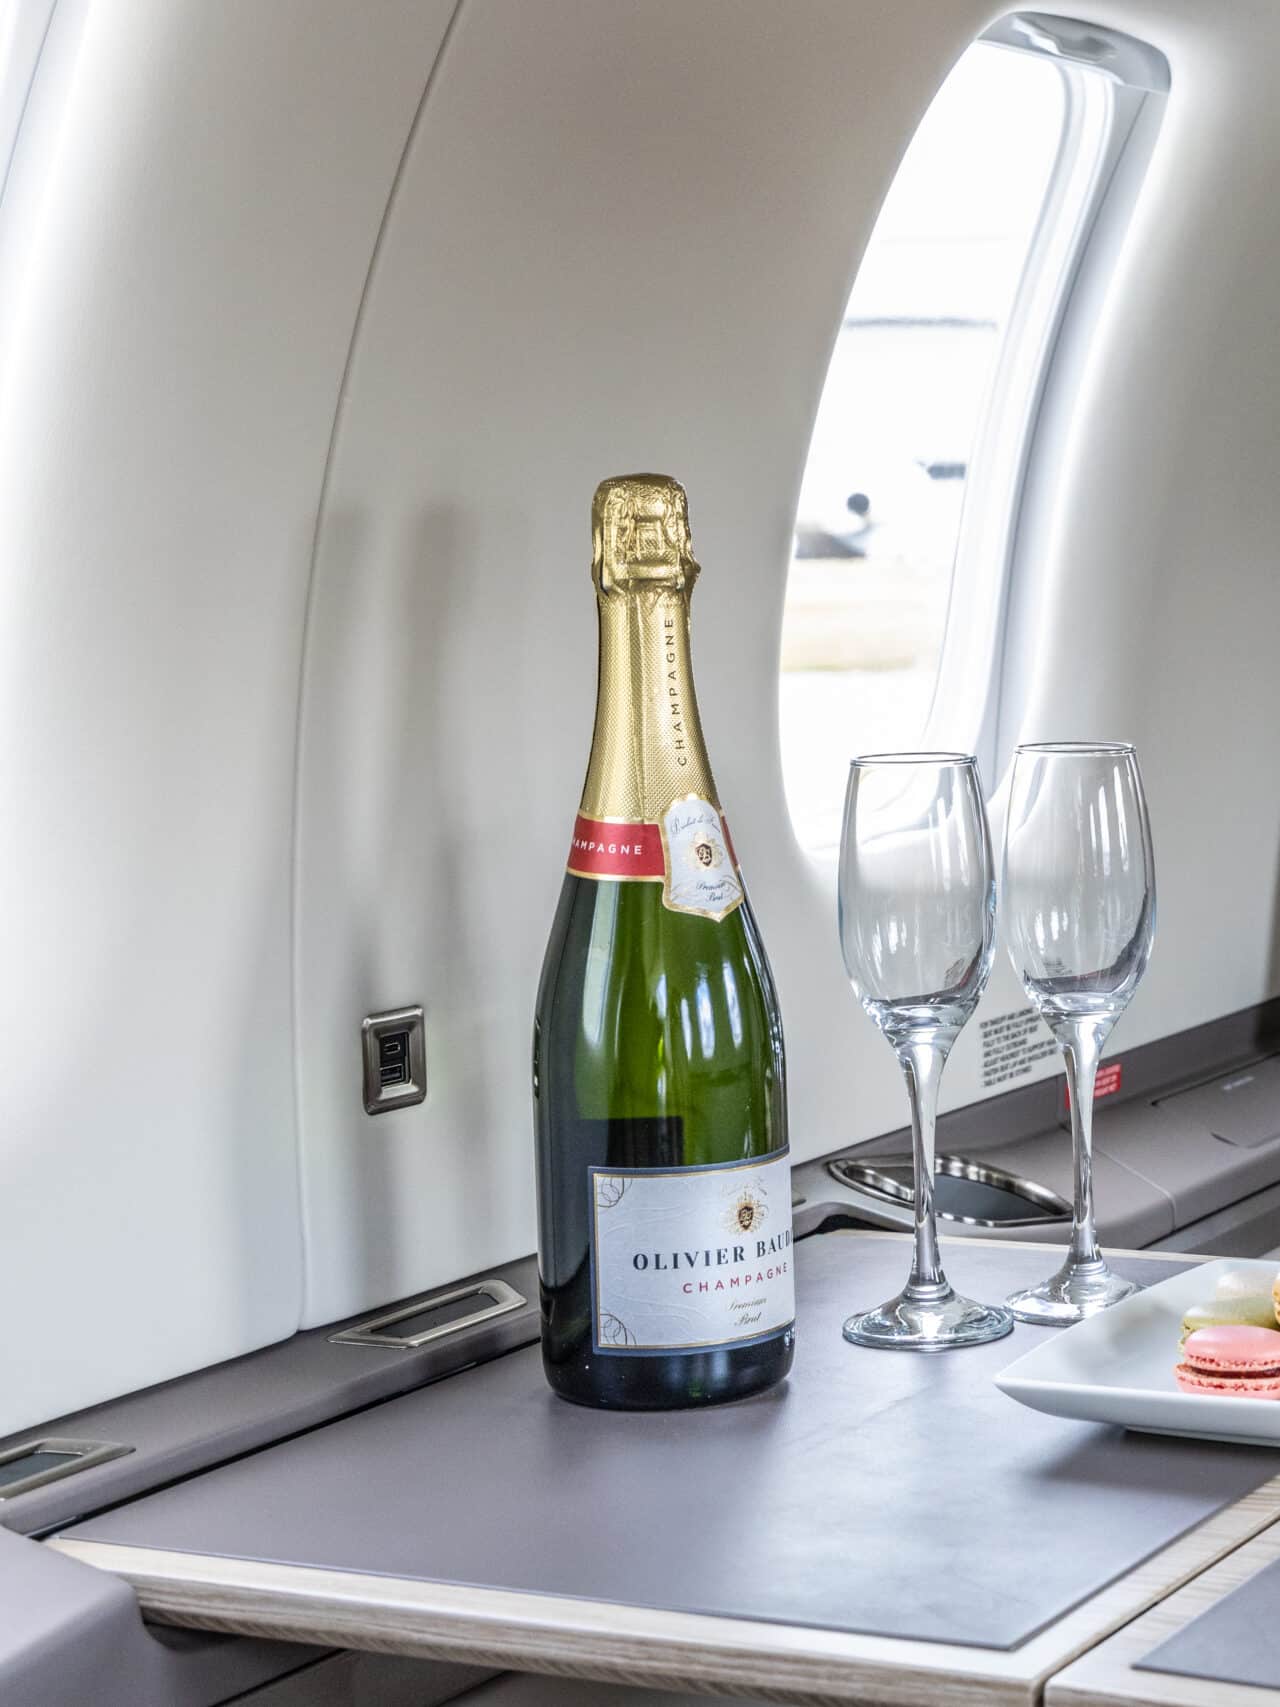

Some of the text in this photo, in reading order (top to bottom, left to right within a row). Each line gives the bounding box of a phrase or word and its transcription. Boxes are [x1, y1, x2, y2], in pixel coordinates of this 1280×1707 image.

[664, 619, 687, 766] CHAMPAGNE
[632, 1228, 794, 1271] OLIVIER BAUD
[682, 1262, 788, 1294] CHAMPAGNE
